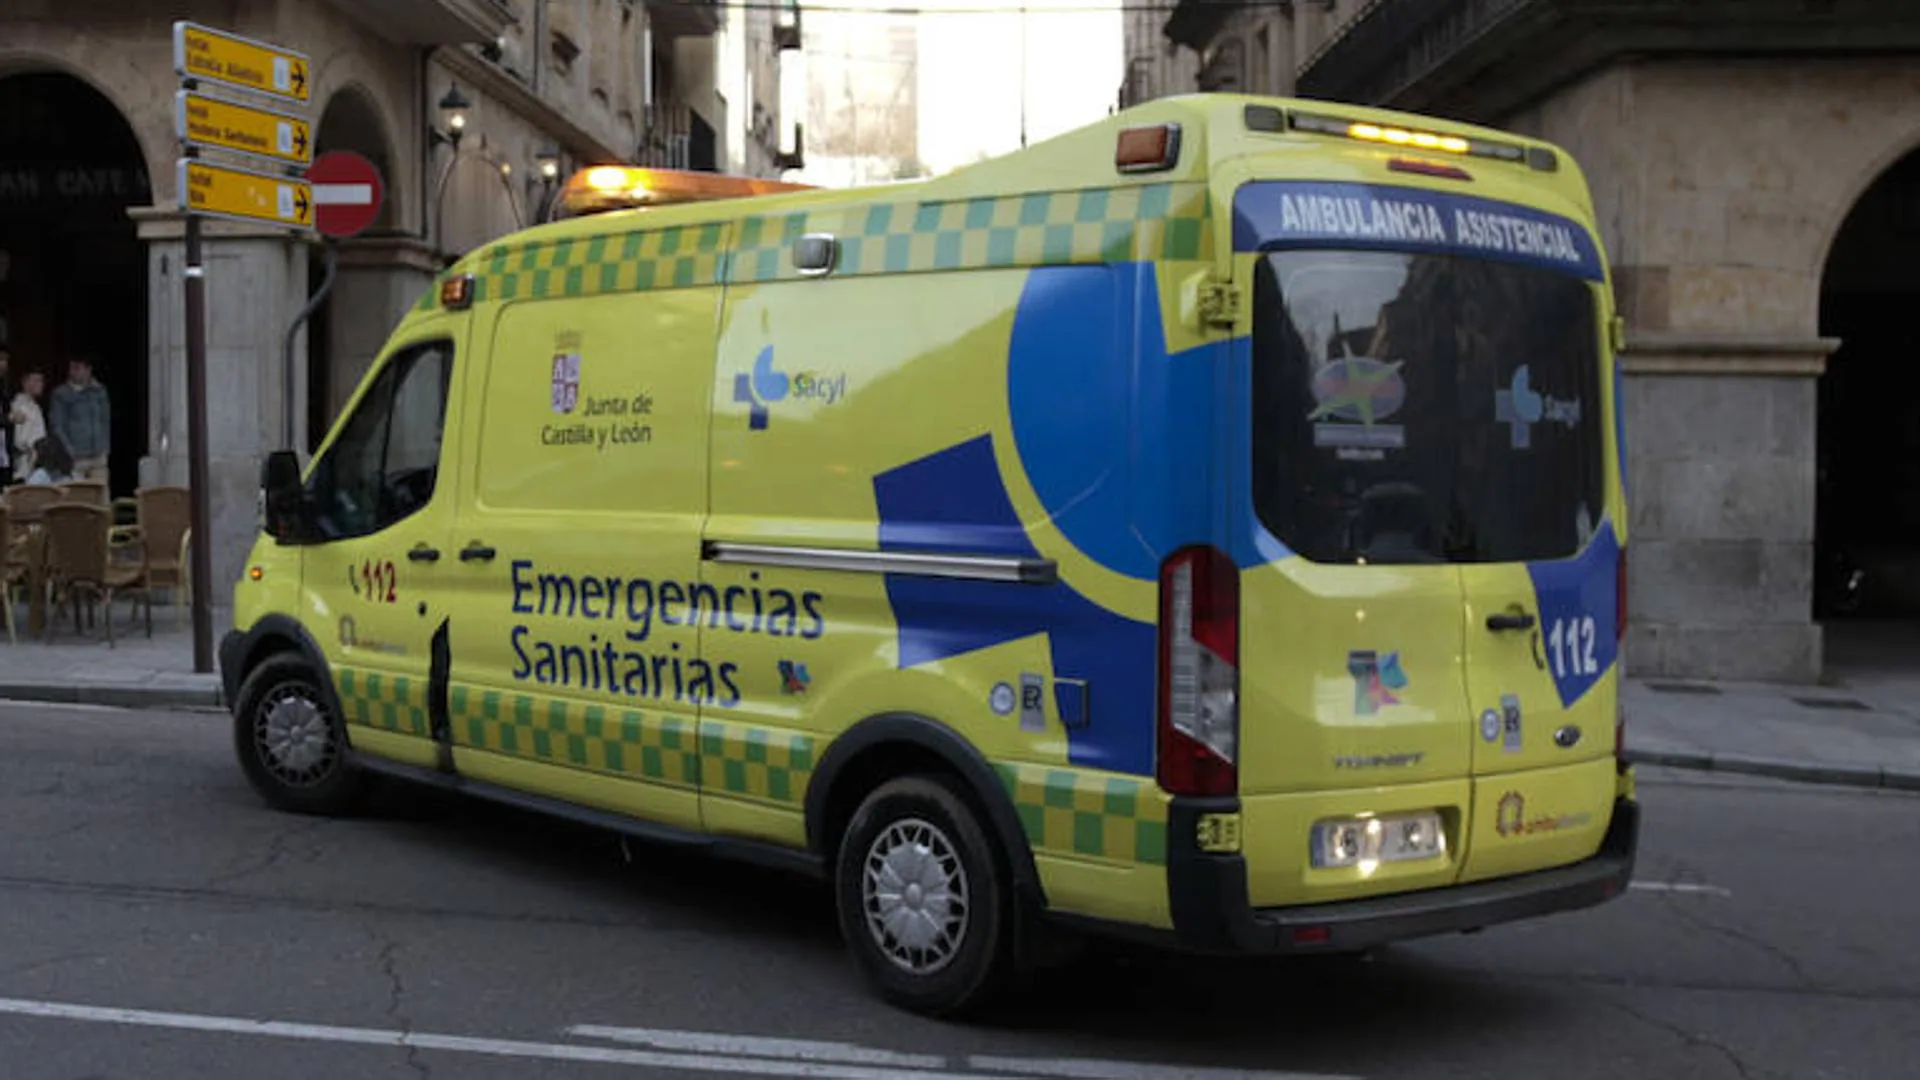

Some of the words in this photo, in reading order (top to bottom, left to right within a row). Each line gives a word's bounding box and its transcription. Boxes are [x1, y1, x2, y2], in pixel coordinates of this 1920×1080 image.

[1280, 194, 1446, 241] AMBULANCIA
[1454, 209, 1580, 261] ASISTENCIAL
[583, 396, 629, 417] Junta
[632, 391, 653, 415] de
[793, 373, 846, 404] Sacyl
[541, 424, 594, 446] Castilla
[597, 429, 606, 450] y
[611, 422, 652, 444] León
[362, 562, 397, 603] 112
[511, 560, 825, 641] Emergencias
[511, 625, 742, 708] Sanitarias
[1550, 617, 1597, 678] 112
